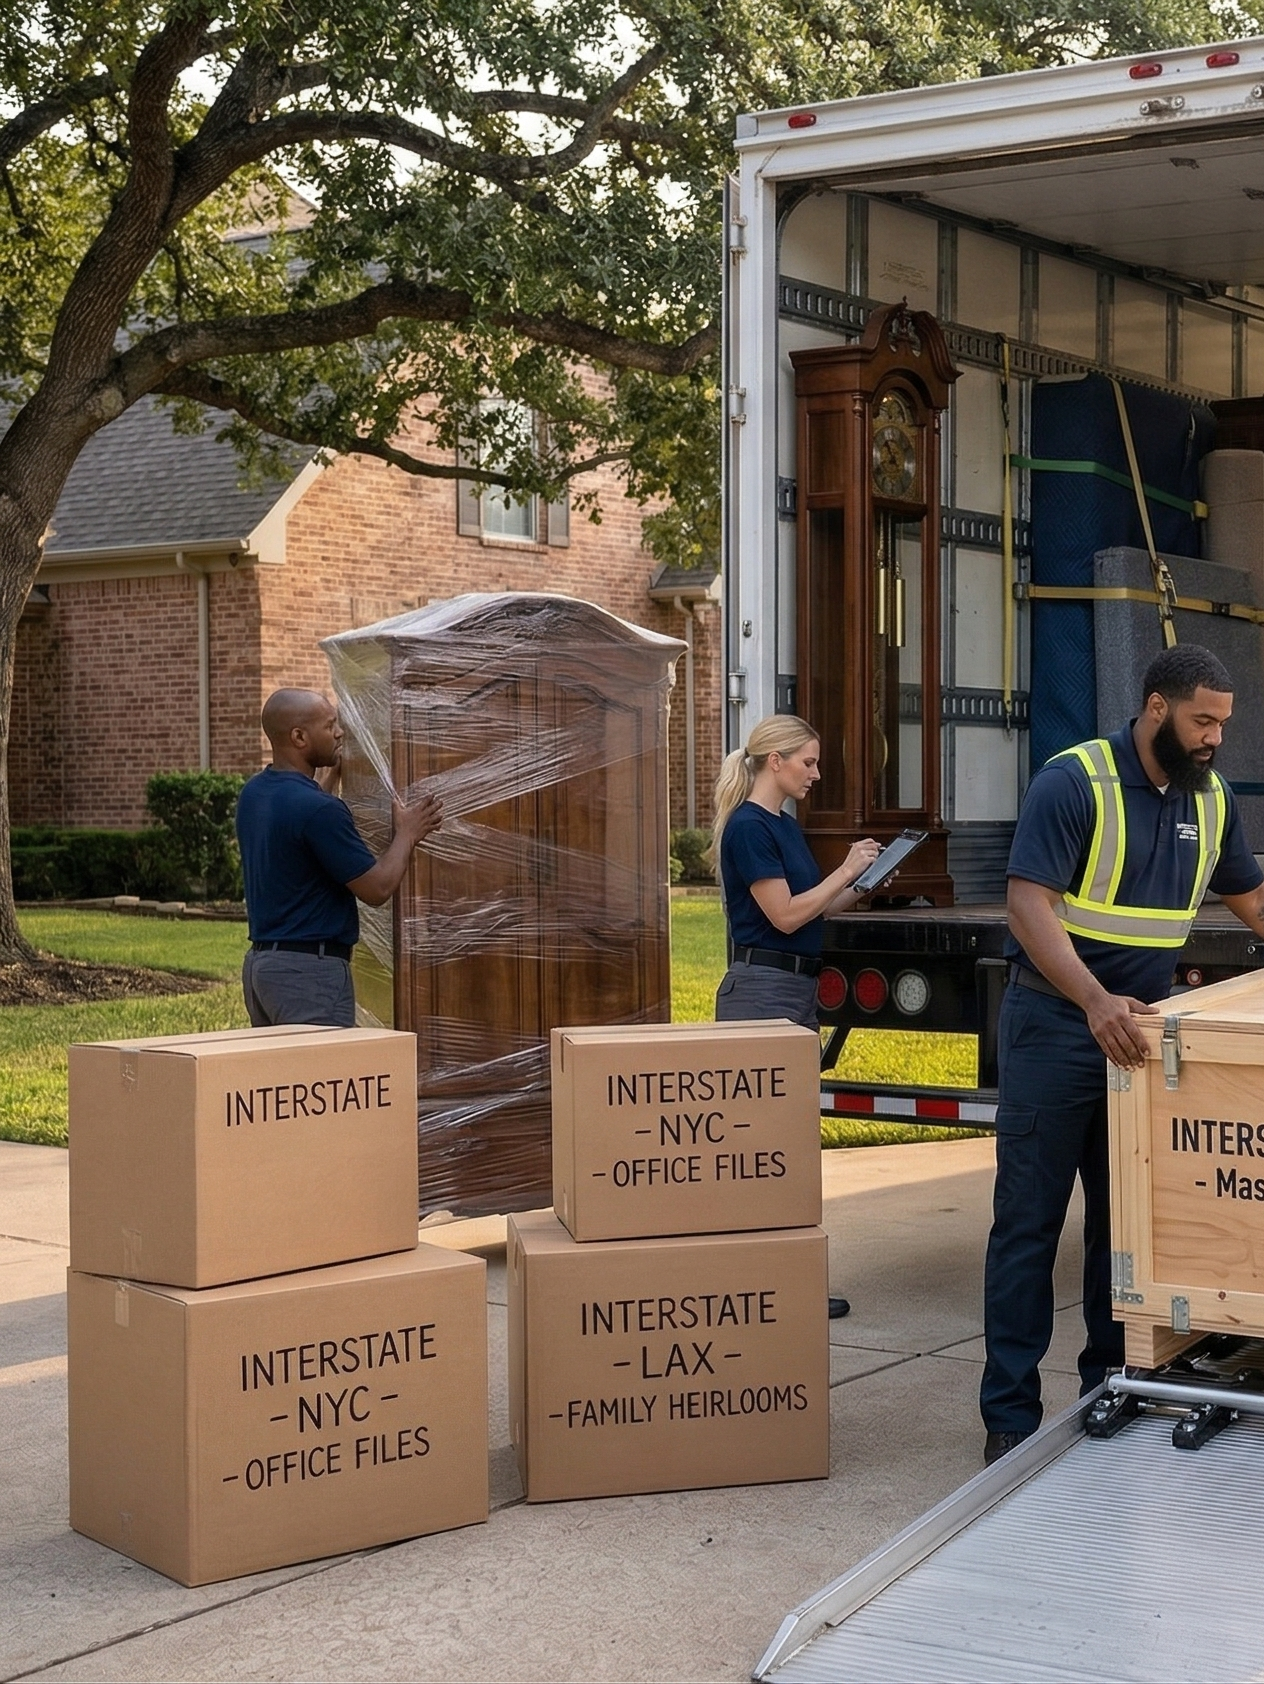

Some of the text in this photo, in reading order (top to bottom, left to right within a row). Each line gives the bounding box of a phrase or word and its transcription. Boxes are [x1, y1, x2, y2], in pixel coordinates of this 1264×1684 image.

[226, 1074, 392, 1127] INTERSTATE
[607, 1067, 786, 1106] INTERSTATE
[715, 1150, 786, 1181] FILES
[581, 1291, 776, 1335] INTERSTATE
[241, 1324, 437, 1392] INTERSTATE
[669, 1384, 808, 1420] HEIRLOOMS
[355, 1426, 430, 1469] FILES
